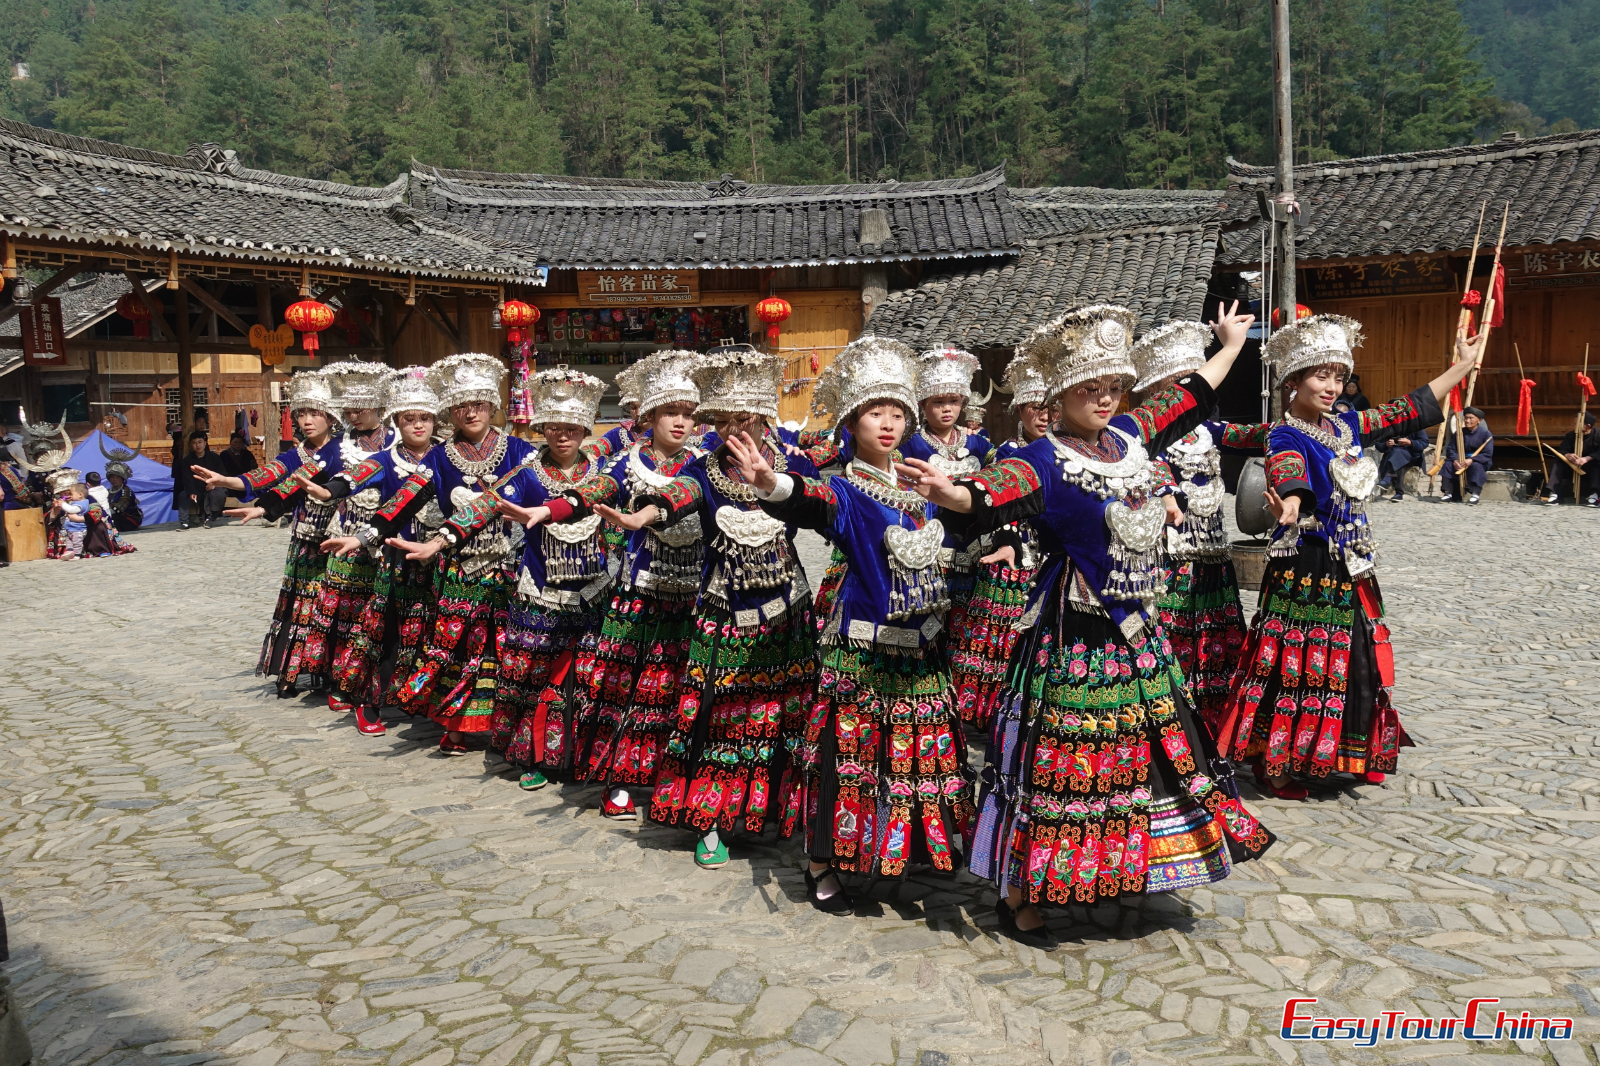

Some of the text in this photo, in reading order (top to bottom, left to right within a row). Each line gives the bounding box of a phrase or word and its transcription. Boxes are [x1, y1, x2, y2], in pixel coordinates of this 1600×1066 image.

[597, 273, 680, 292] 怡客苗家
[40, 303, 53, 350] 表演场出口
